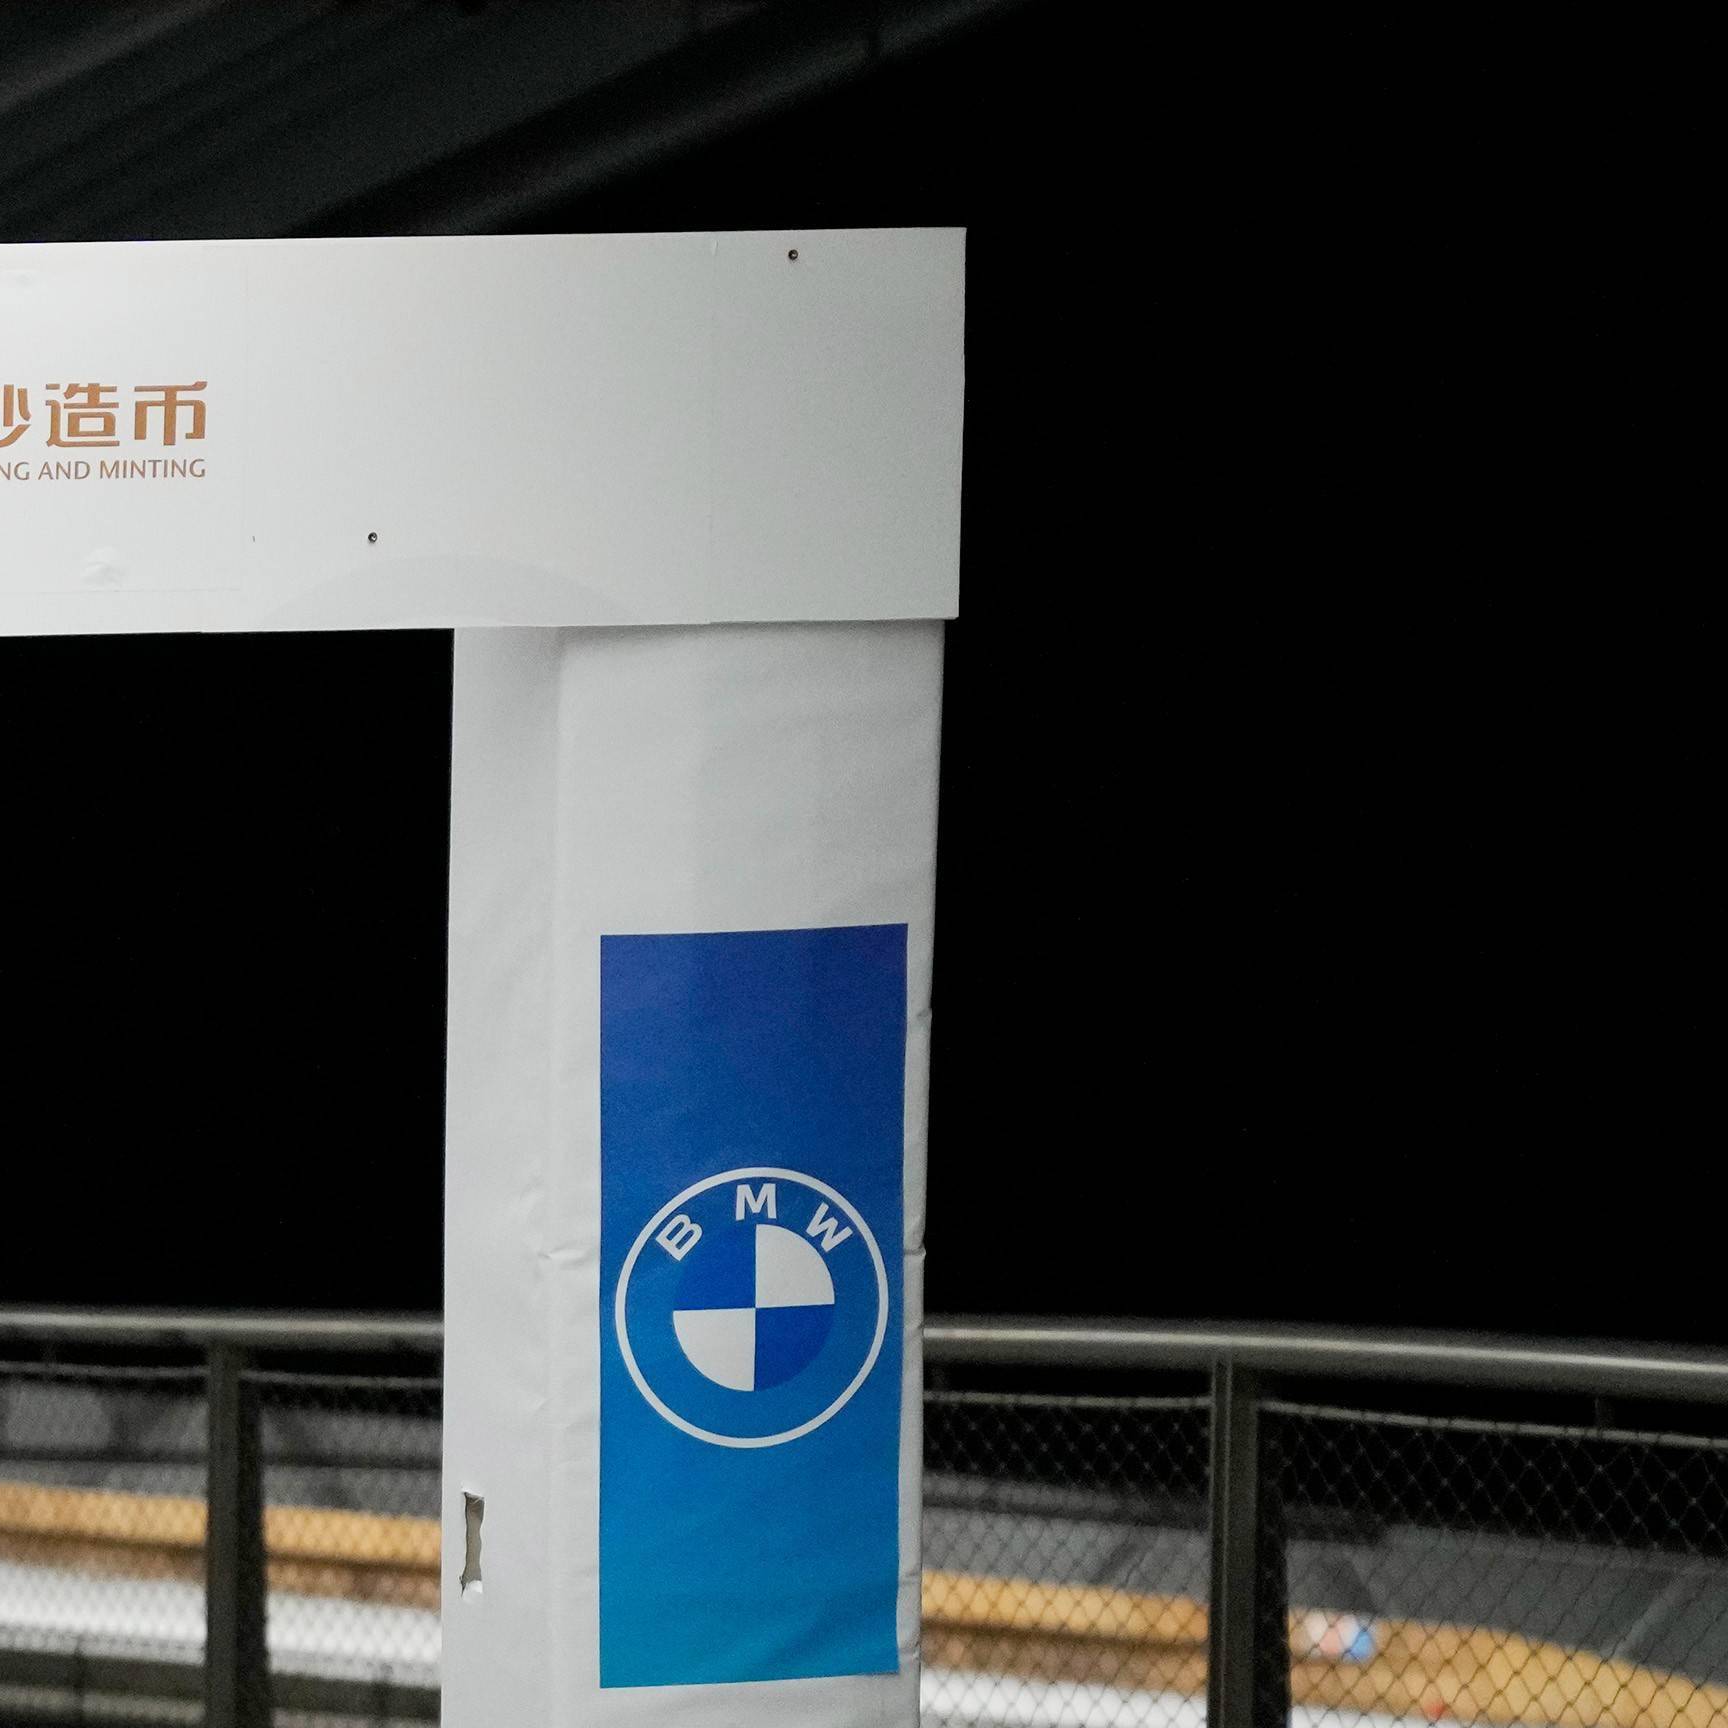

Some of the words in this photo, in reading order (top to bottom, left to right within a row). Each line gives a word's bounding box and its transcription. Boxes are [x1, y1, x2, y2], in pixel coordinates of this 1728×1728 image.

[37, 460, 91, 481] AND
[99, 458, 207, 480] MINTING
[655, 1183, 853, 1262] BMW
